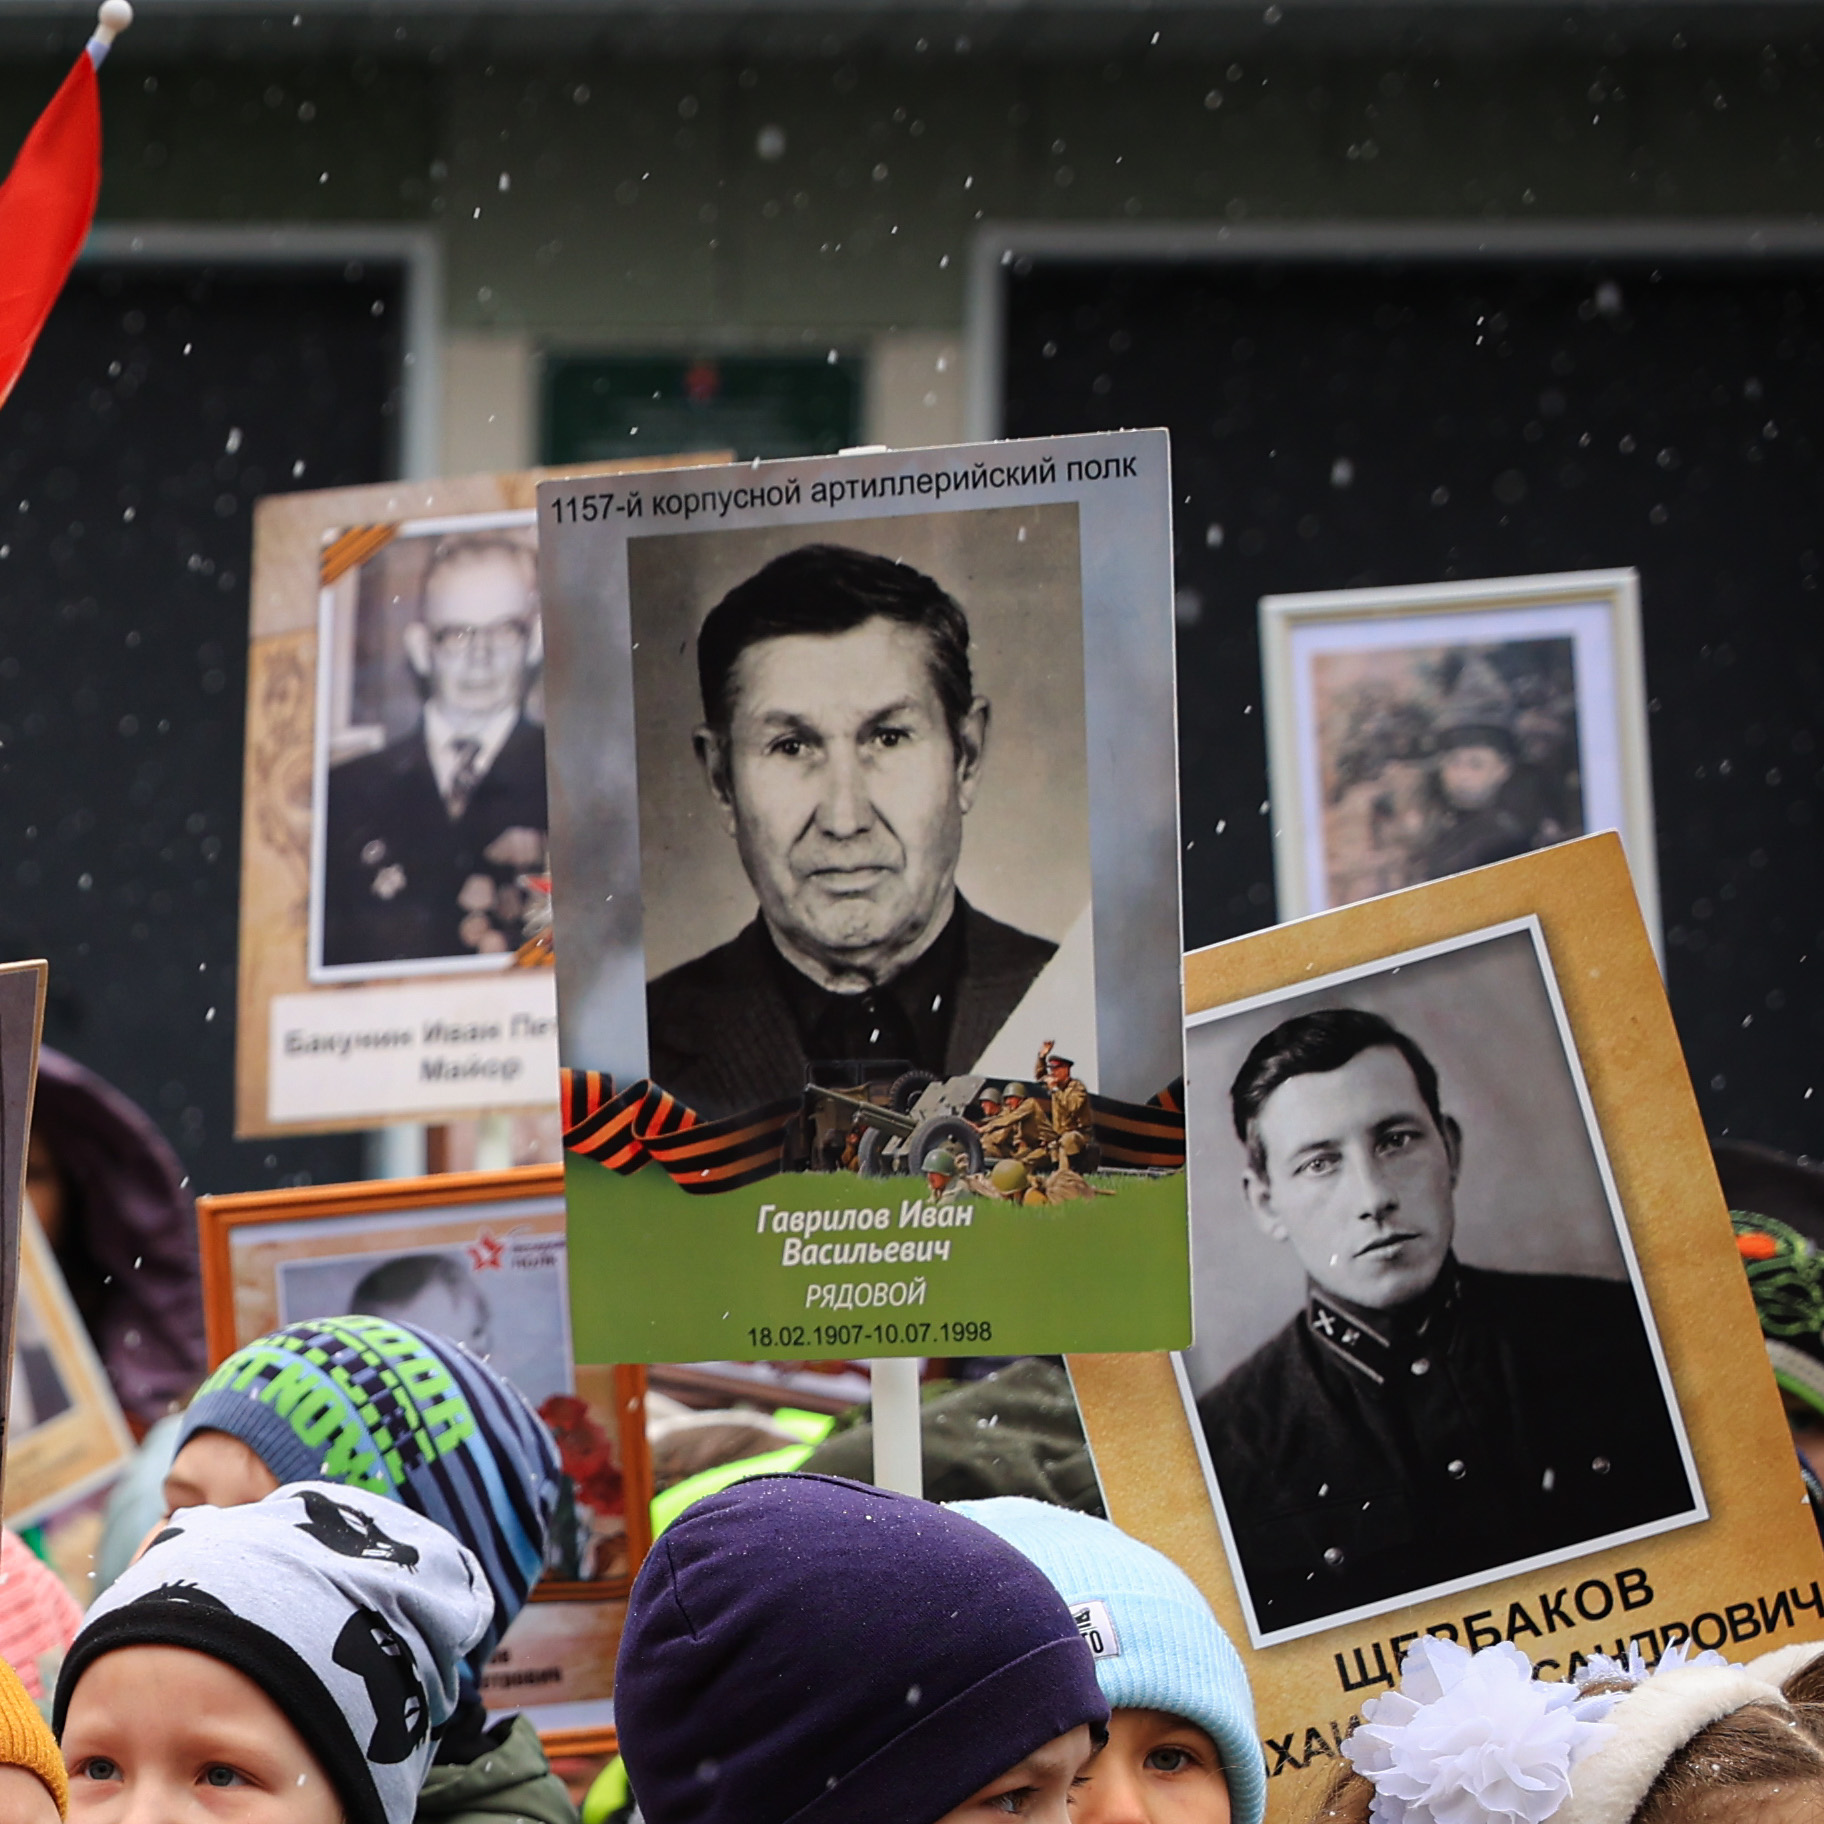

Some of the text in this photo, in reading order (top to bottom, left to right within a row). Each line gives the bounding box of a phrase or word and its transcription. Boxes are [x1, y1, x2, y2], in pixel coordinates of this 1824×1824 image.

[552, 454, 1137, 525] 1157-й корпусной артиллерийский полк
[756, 1199, 975, 1239] Гаврилов Иван
[780, 1236, 952, 1267] Васильевич
[804, 1275, 928, 1311] РЯДОВОЙ
[747, 1320, 993, 1348] 18.02.1907-10.07.1998
